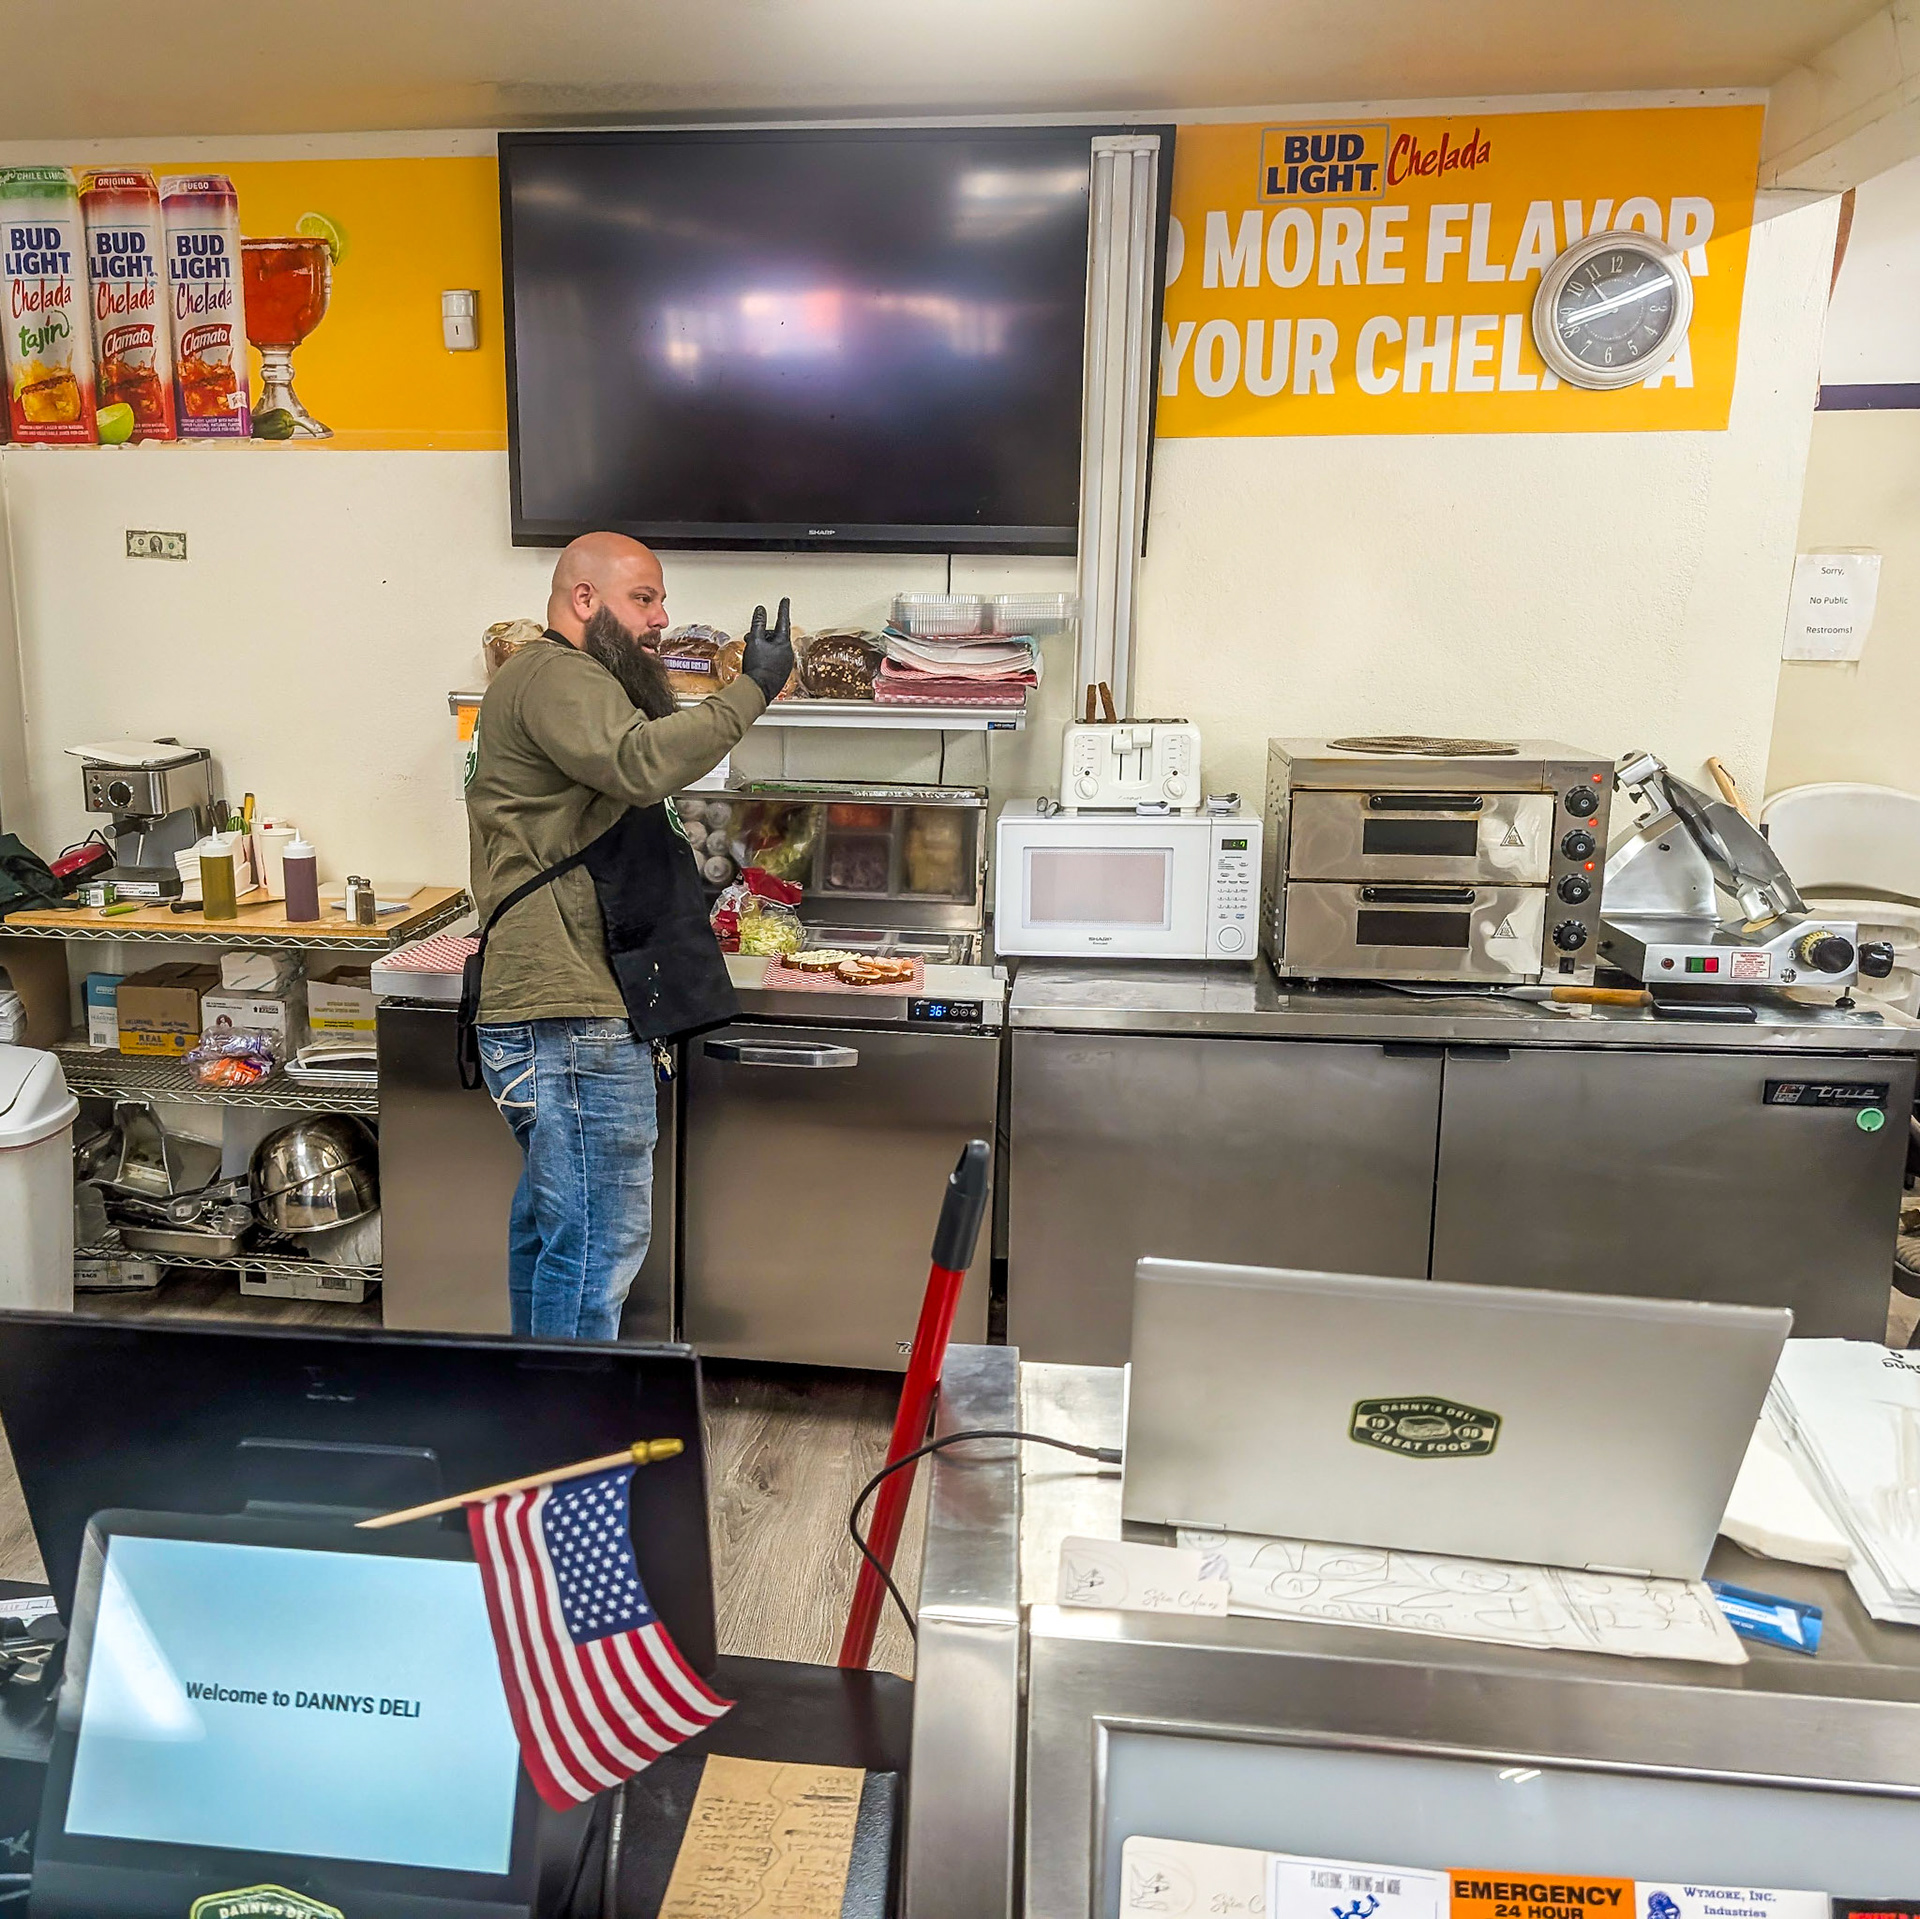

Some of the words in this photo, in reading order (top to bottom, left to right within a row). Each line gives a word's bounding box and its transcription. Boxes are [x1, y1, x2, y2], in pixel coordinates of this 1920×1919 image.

[1284, 134, 1365, 164] BUD
[1387, 128, 1491, 186] Chelada
[97, 175, 137, 187] ORIGINAL
[10, 228, 61, 251] BUD
[96, 232, 146, 255] BUD
[177, 235, 225, 257] BUD
[1203, 206, 1409, 289] MORE
[5, 252, 71, 276] LIGHT
[91, 255, 153, 279] LIGHT
[171, 258, 231, 280] LIGHT
[11, 274, 73, 319] Chelada
[97, 278, 156, 321] Chelada
[176, 279, 233, 321] Chelada
[105, 327, 151, 357] Clamato
[183, 327, 228, 356] Clamato
[1161, 317, 1339, 398] YOUR
[1355, 315, 1695, 396] CHELA
[1821, 567, 1845, 576] Sorry,
[1810, 597, 1822, 605] No
[1824, 597, 1848, 605] Public
[1806, 626, 1853, 634] Restrooms!
[929, 1005, 943, 1017] 36
[1380, 1403, 1443, 1413] DANNY'S
[1446, 1407, 1477, 1422] DELI
[1371, 1432, 1422, 1451] GREAT
[1427, 1442, 1472, 1452] FOOD
[186, 1681, 268, 1705] Welcome
[273, 1690, 290, 1707] to
[295, 1691, 374, 1714] DANNYS
[379, 1698, 421, 1718] DELI
[1454, 1880, 1622, 1906] EMERGENCY
[1684, 1886, 1745, 1902] WYMORE,
[1495, 1904, 1521, 1917] 24
[1528, 1906, 1584, 1919] HOUR
[1704, 1905, 1767, 1919] Industries
